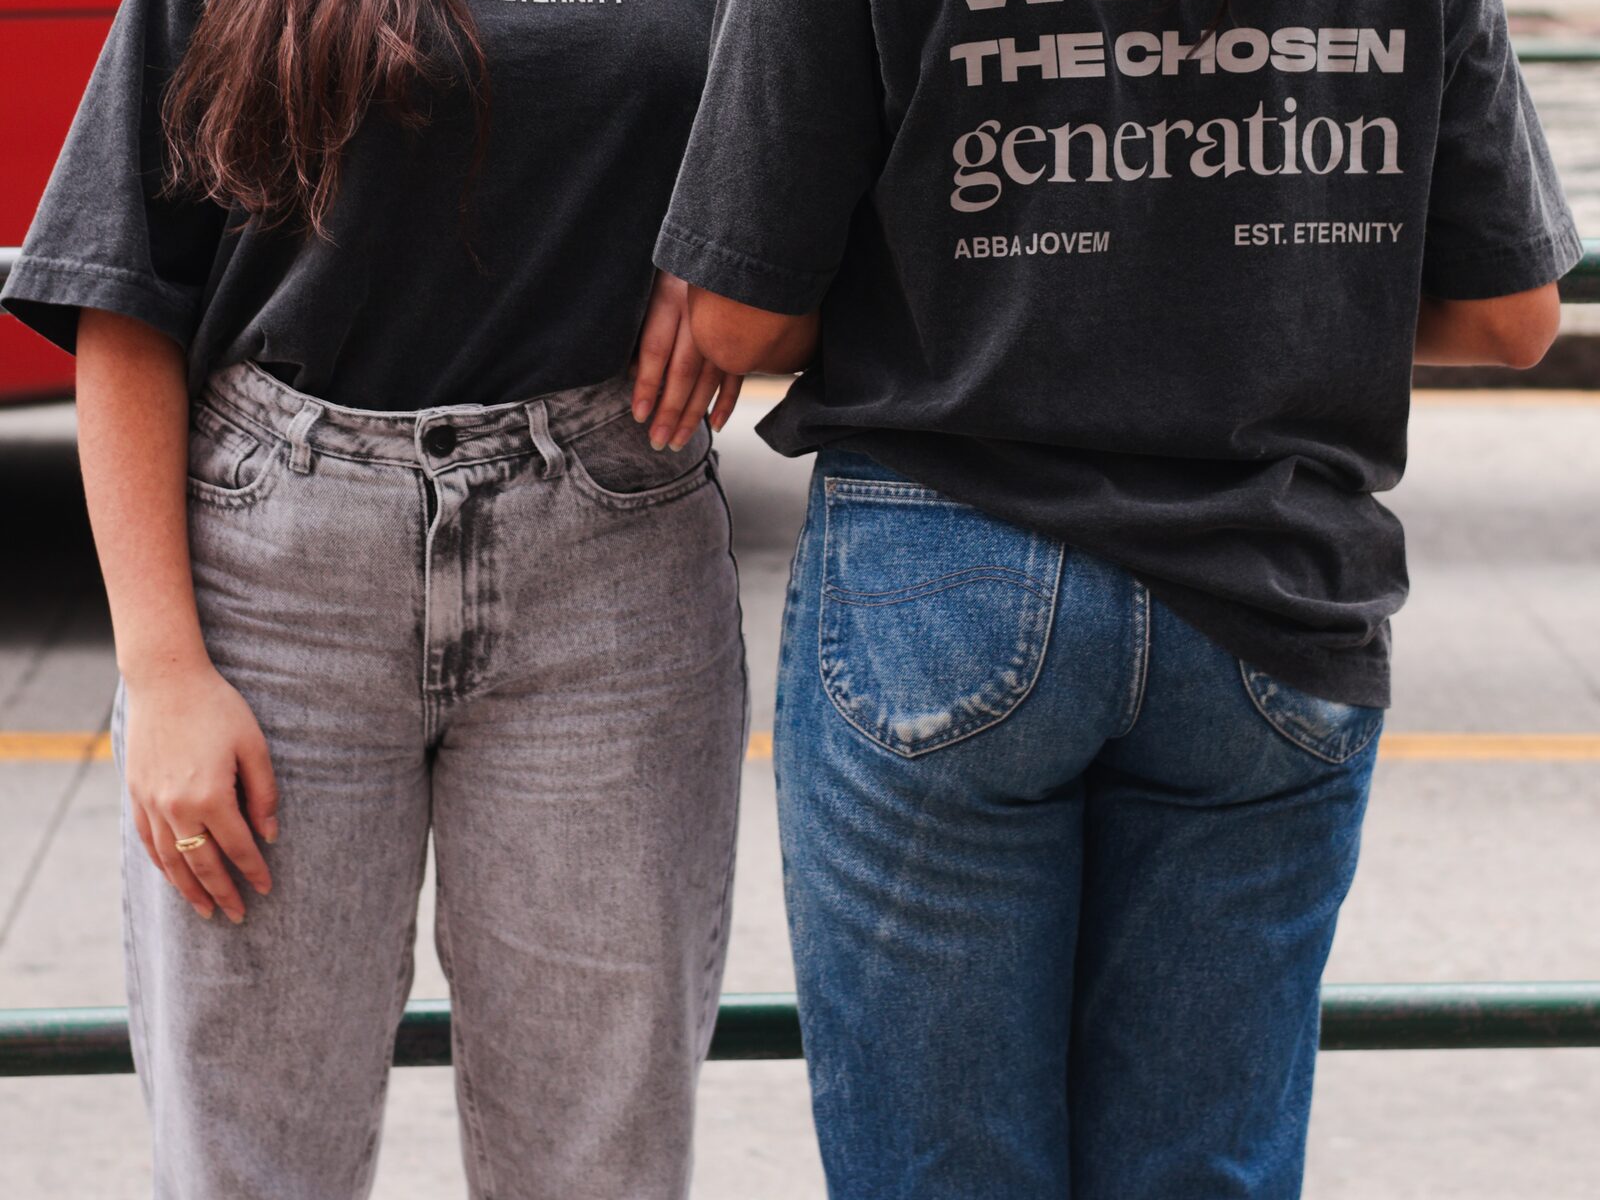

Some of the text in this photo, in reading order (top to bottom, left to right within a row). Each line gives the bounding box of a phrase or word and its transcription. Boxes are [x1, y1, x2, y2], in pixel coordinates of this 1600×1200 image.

[950, 27, 1405, 86] THE CHOSEN
[950, 97, 1403, 213] generation
[1234, 222, 1403, 246] EST. ETERNITY
